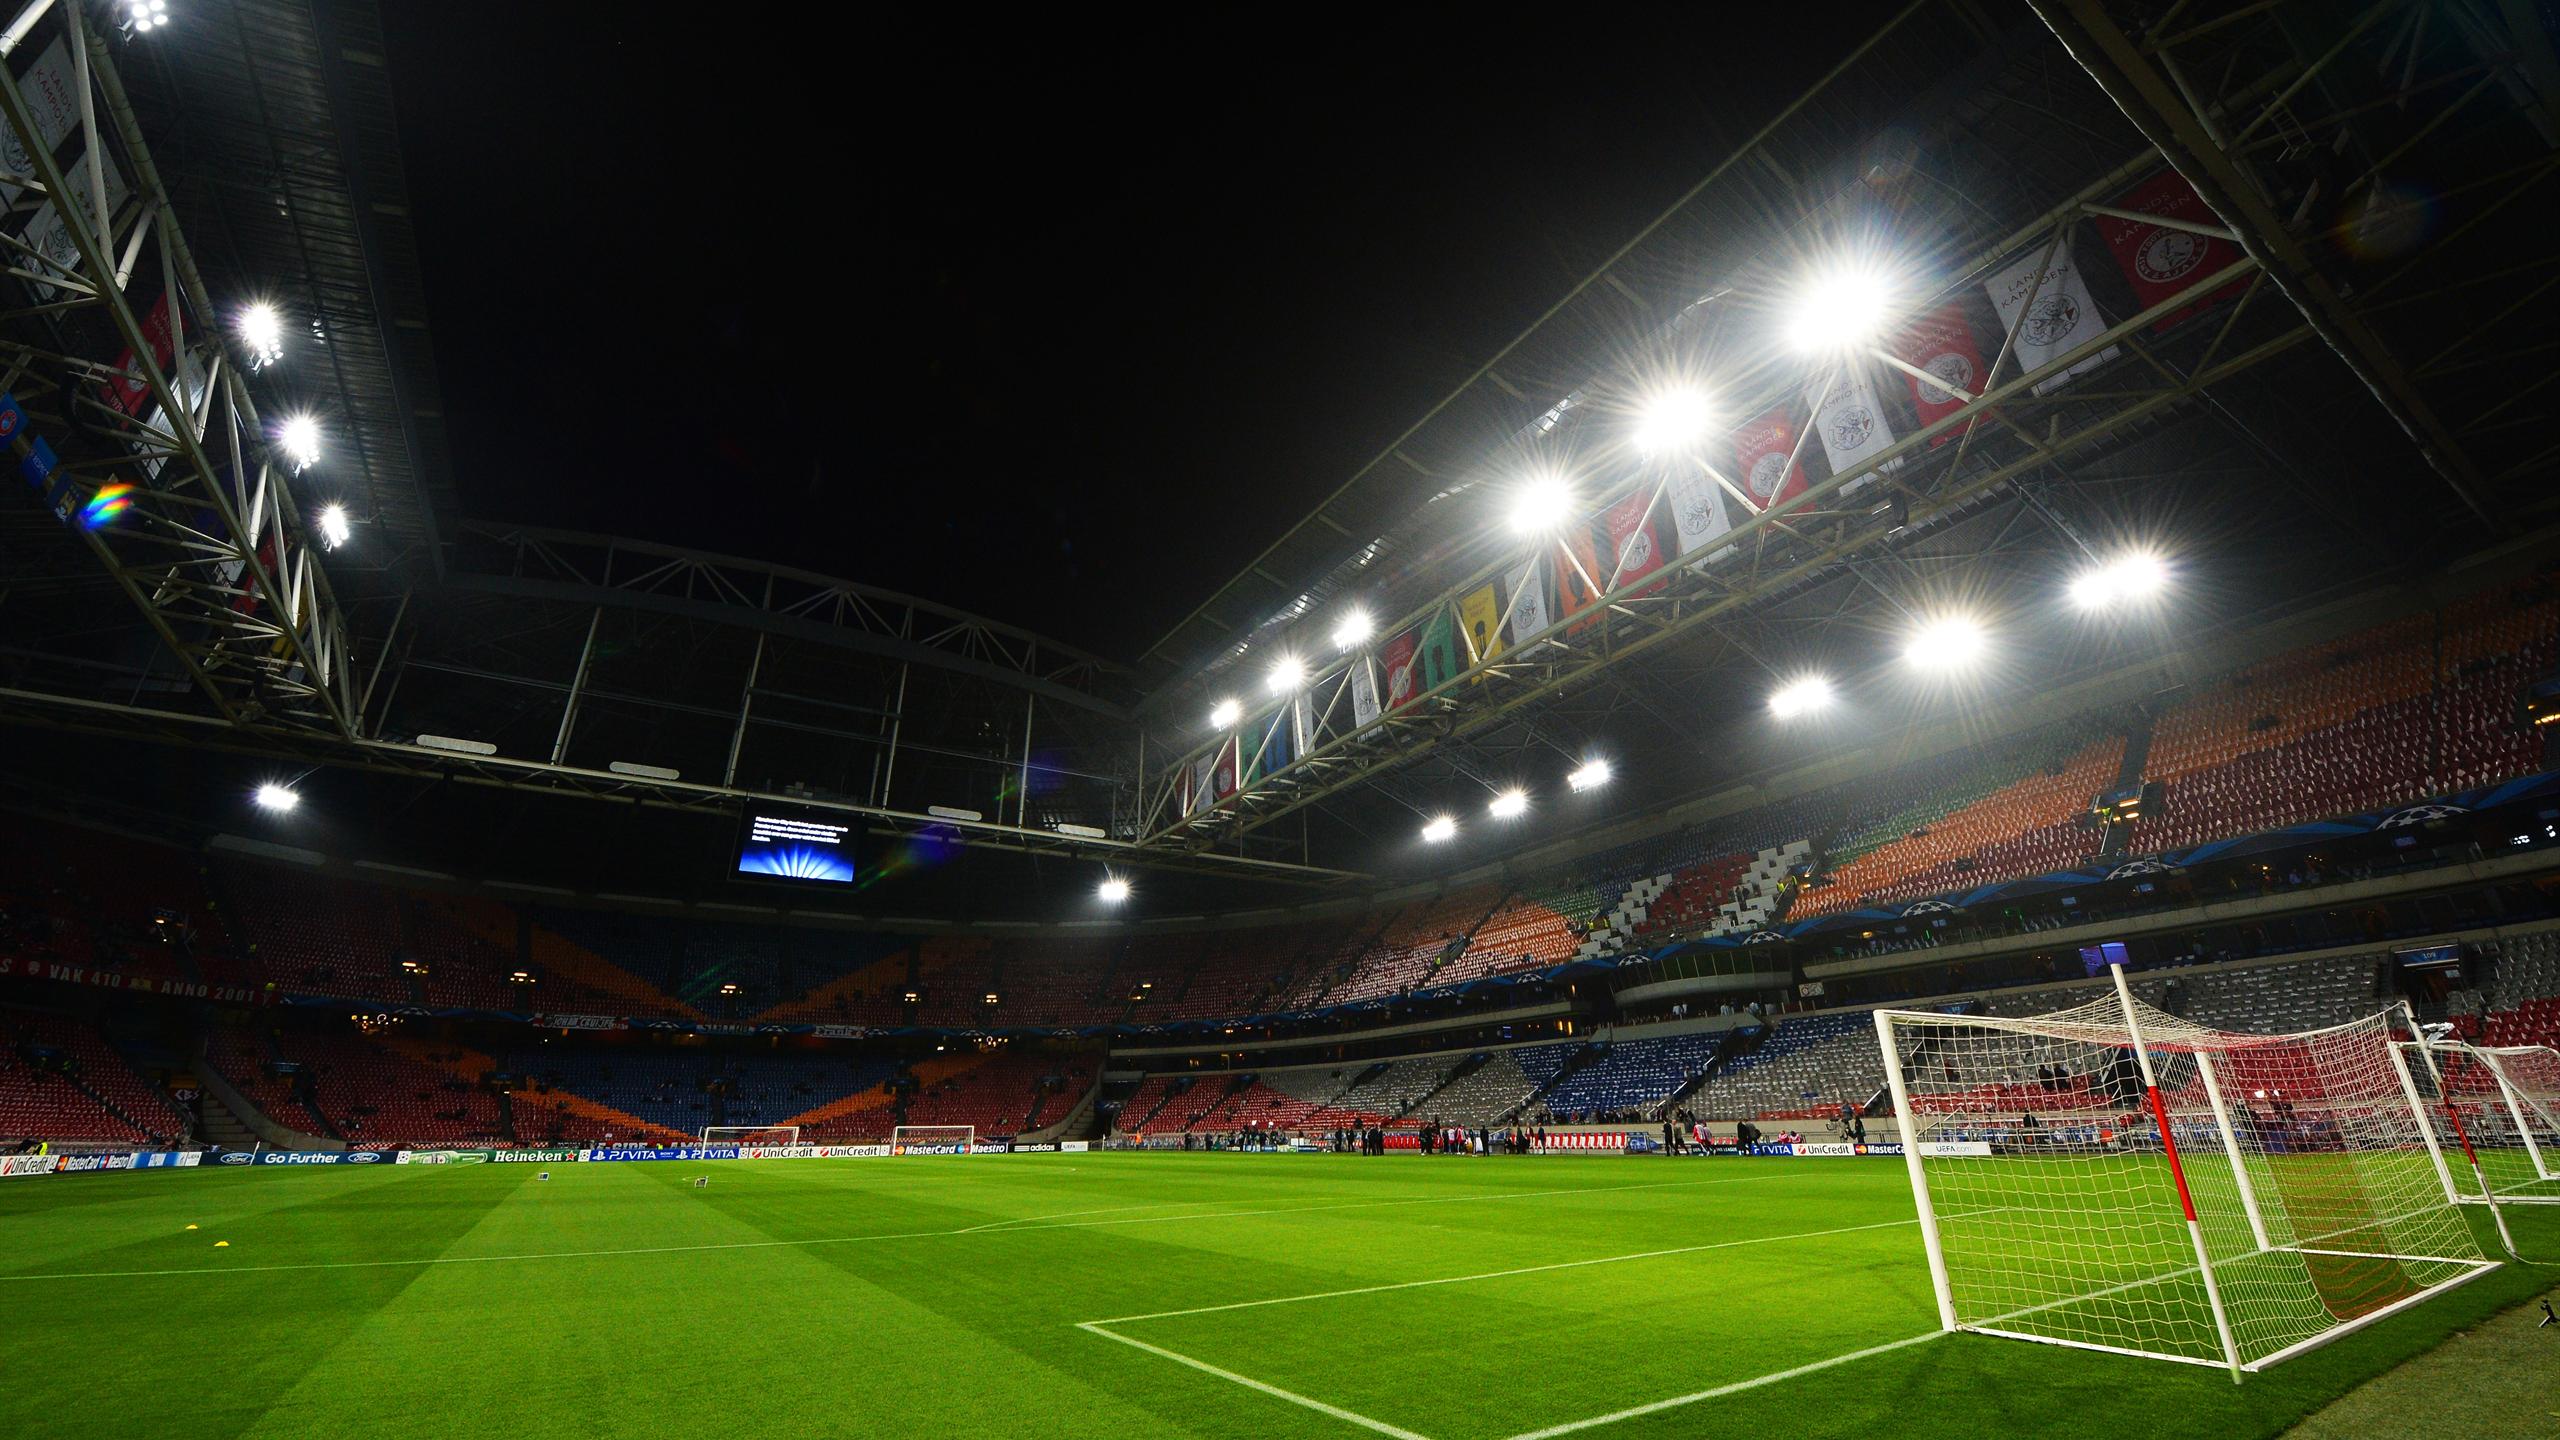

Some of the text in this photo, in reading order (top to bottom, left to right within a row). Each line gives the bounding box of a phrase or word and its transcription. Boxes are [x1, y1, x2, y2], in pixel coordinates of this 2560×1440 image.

[49, 963, 82, 984] VAK
[90, 971, 121, 988] 410
[161, 980, 254, 1002] ANNO 2001
[763, 1147, 813, 1158] UniCredit
[830, 1145, 878, 1157] UniCredit
[905, 1144, 1005, 1154] MasterCard Maestro
[1030, 1143, 1055, 1152] adidas
[1808, 1145, 1850, 1154] UniCredit
[1867, 1145, 1905, 1154] MasterCa
[226, 1153, 248, 1163] Ford
[265, 1152, 339, 1164] Go Further
[353, 1153, 373, 1162] Ford
[494, 1150, 562, 1162] Heineken
[10, 1155, 48, 1174] UniCredit
[68, 1155, 130, 1171] MasterCard Maestro
